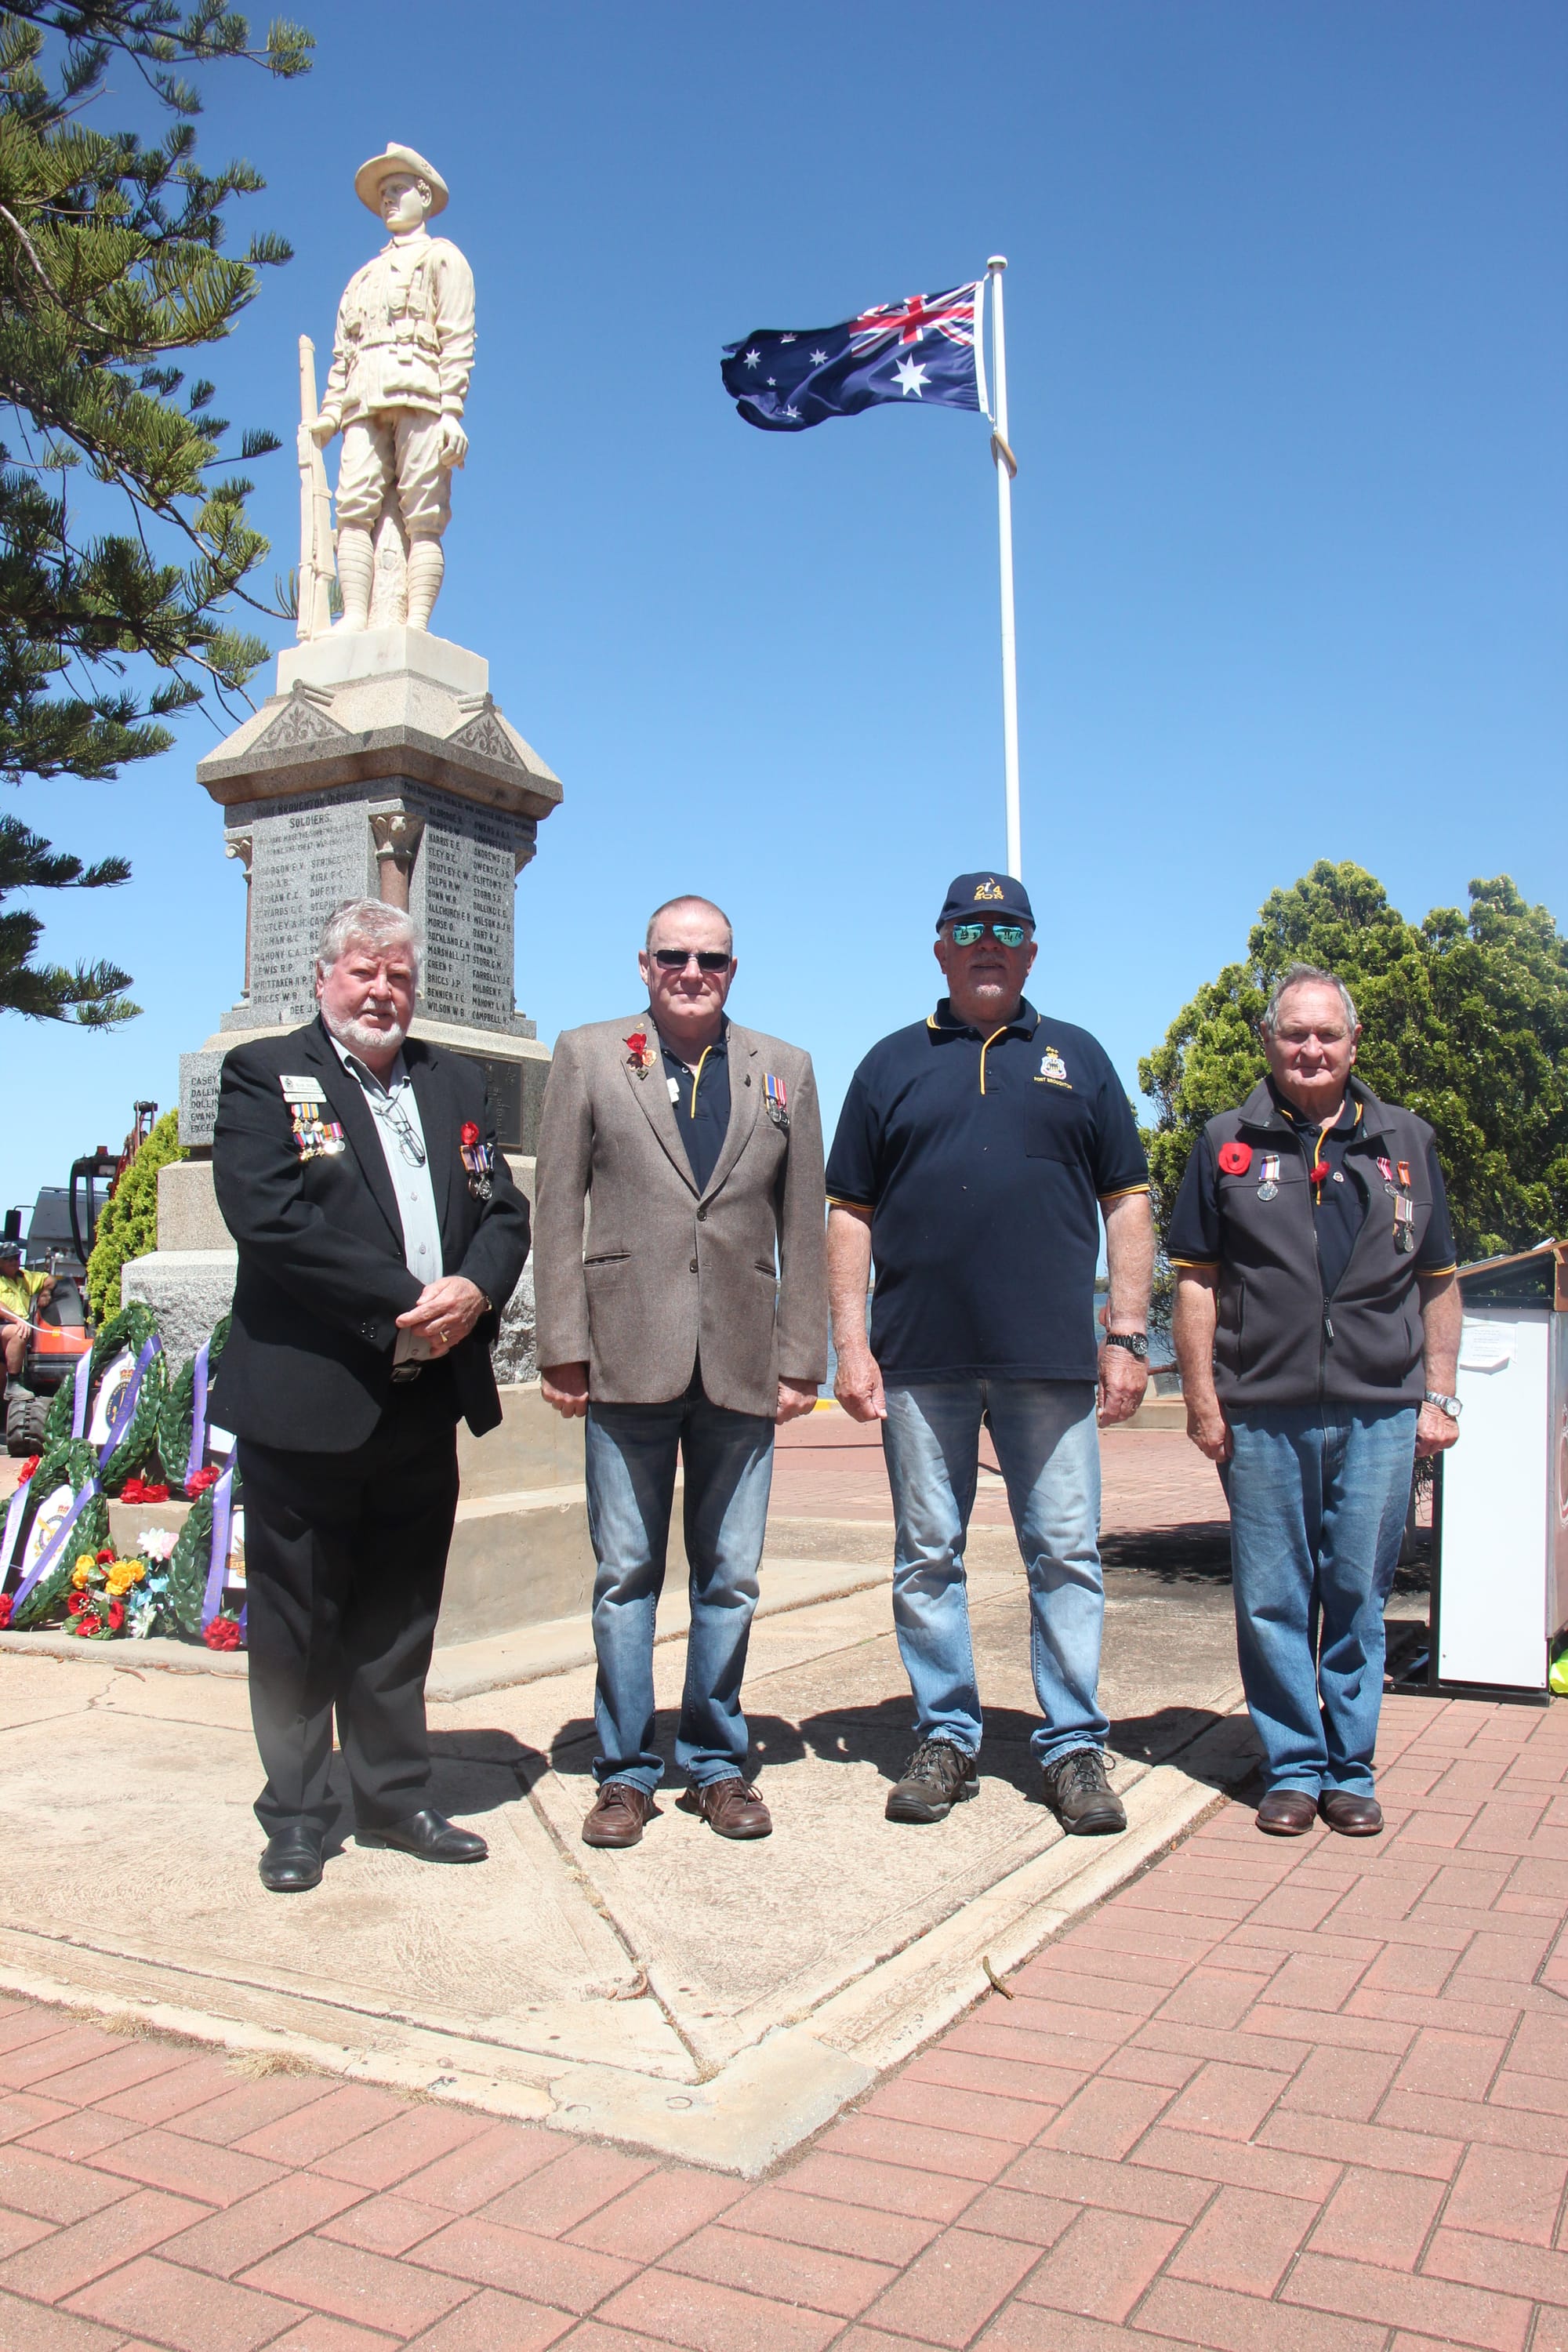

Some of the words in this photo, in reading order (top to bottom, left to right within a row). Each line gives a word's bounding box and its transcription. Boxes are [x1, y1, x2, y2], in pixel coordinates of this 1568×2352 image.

[429, 833, 448, 847] HARRIS
[429, 847, 444, 859] ELEY
[474, 847, 500, 863] ANDREWS
[429, 861, 455, 877] ROUTLEY
[474, 861, 493, 874] OWENS
[310, 900, 339, 912] STEPHE
[428, 916, 447, 930] MORSE
[474, 915, 495, 929] WILSON
[428, 931, 458, 946] BUCKLAND
[474, 928, 488, 940] DART
[427, 945, 459, 960] MARSHALL
[254, 965, 278, 975] LEWIS
[254, 978, 293, 990] WHITTAKER
[427, 987, 453, 1000] BENNIER
[290, 1005, 304, 1014] DEE
[427, 1002, 451, 1014] WILSON
[473, 1011, 502, 1024] CAMPBELL
[191, 1076, 217, 1087] CASEY
[1047, 1077, 1073, 1089] BROUGHTON
[191, 1087, 220, 1098] DALLIN
[191, 1100, 220, 1109] DOLLIN
[191, 1123, 214, 1133] EXCEL
